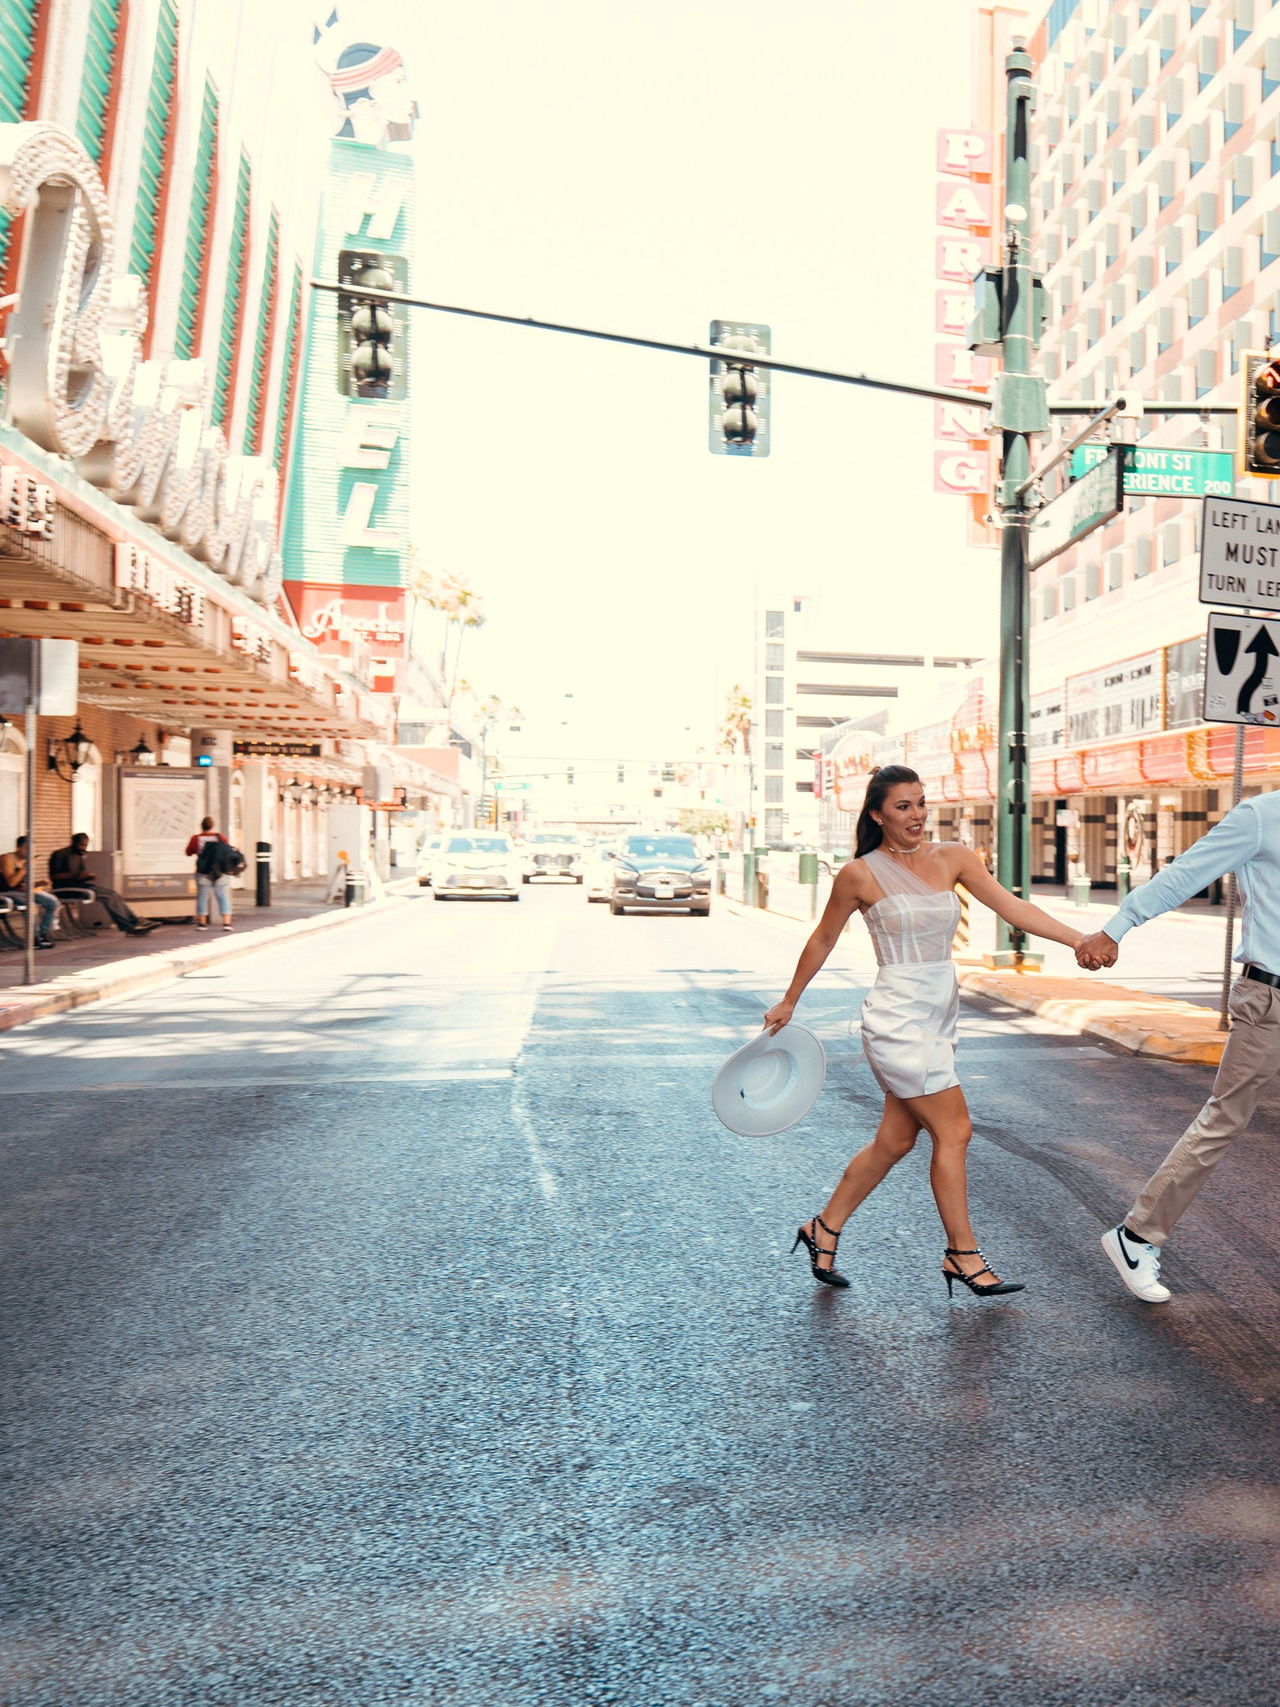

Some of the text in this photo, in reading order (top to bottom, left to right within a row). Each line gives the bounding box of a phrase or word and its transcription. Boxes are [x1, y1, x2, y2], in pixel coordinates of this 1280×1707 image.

[938, 133, 985, 491] PARKING
[340, 172, 405, 547] HEL
[1172, 453, 1193, 472] ST
[1122, 473, 1232, 494] ERIENCE 200
[1212, 511, 1248, 530] LEFT
[1225, 542, 1278, 567] MUST
[1207, 573, 1246, 593] TURN
[302, 599, 406, 641] Apache
